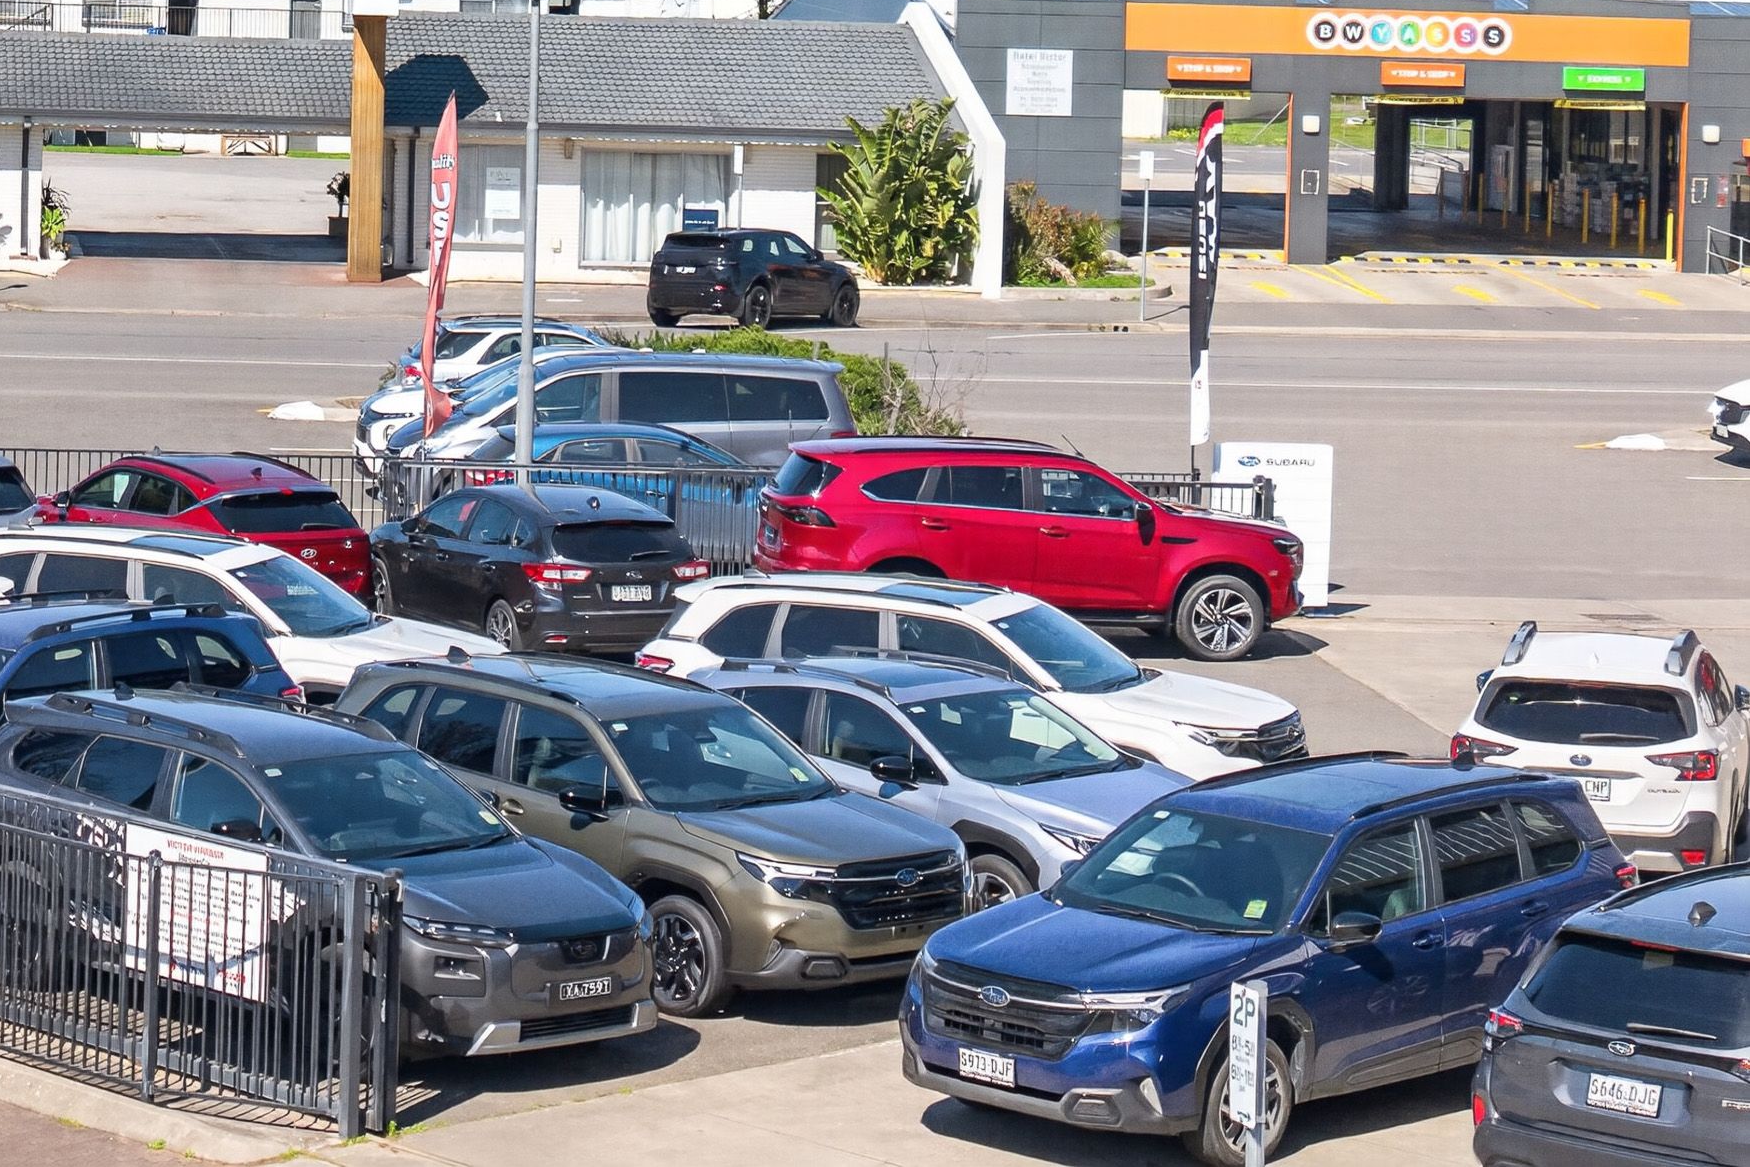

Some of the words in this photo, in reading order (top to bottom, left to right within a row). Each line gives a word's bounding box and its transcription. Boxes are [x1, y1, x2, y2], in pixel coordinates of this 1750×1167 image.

[1266, 458, 1316, 467] SUBARU
[1233, 993, 1255, 1028] 2P
[961, 1051, 1013, 1077] S973-DJF
